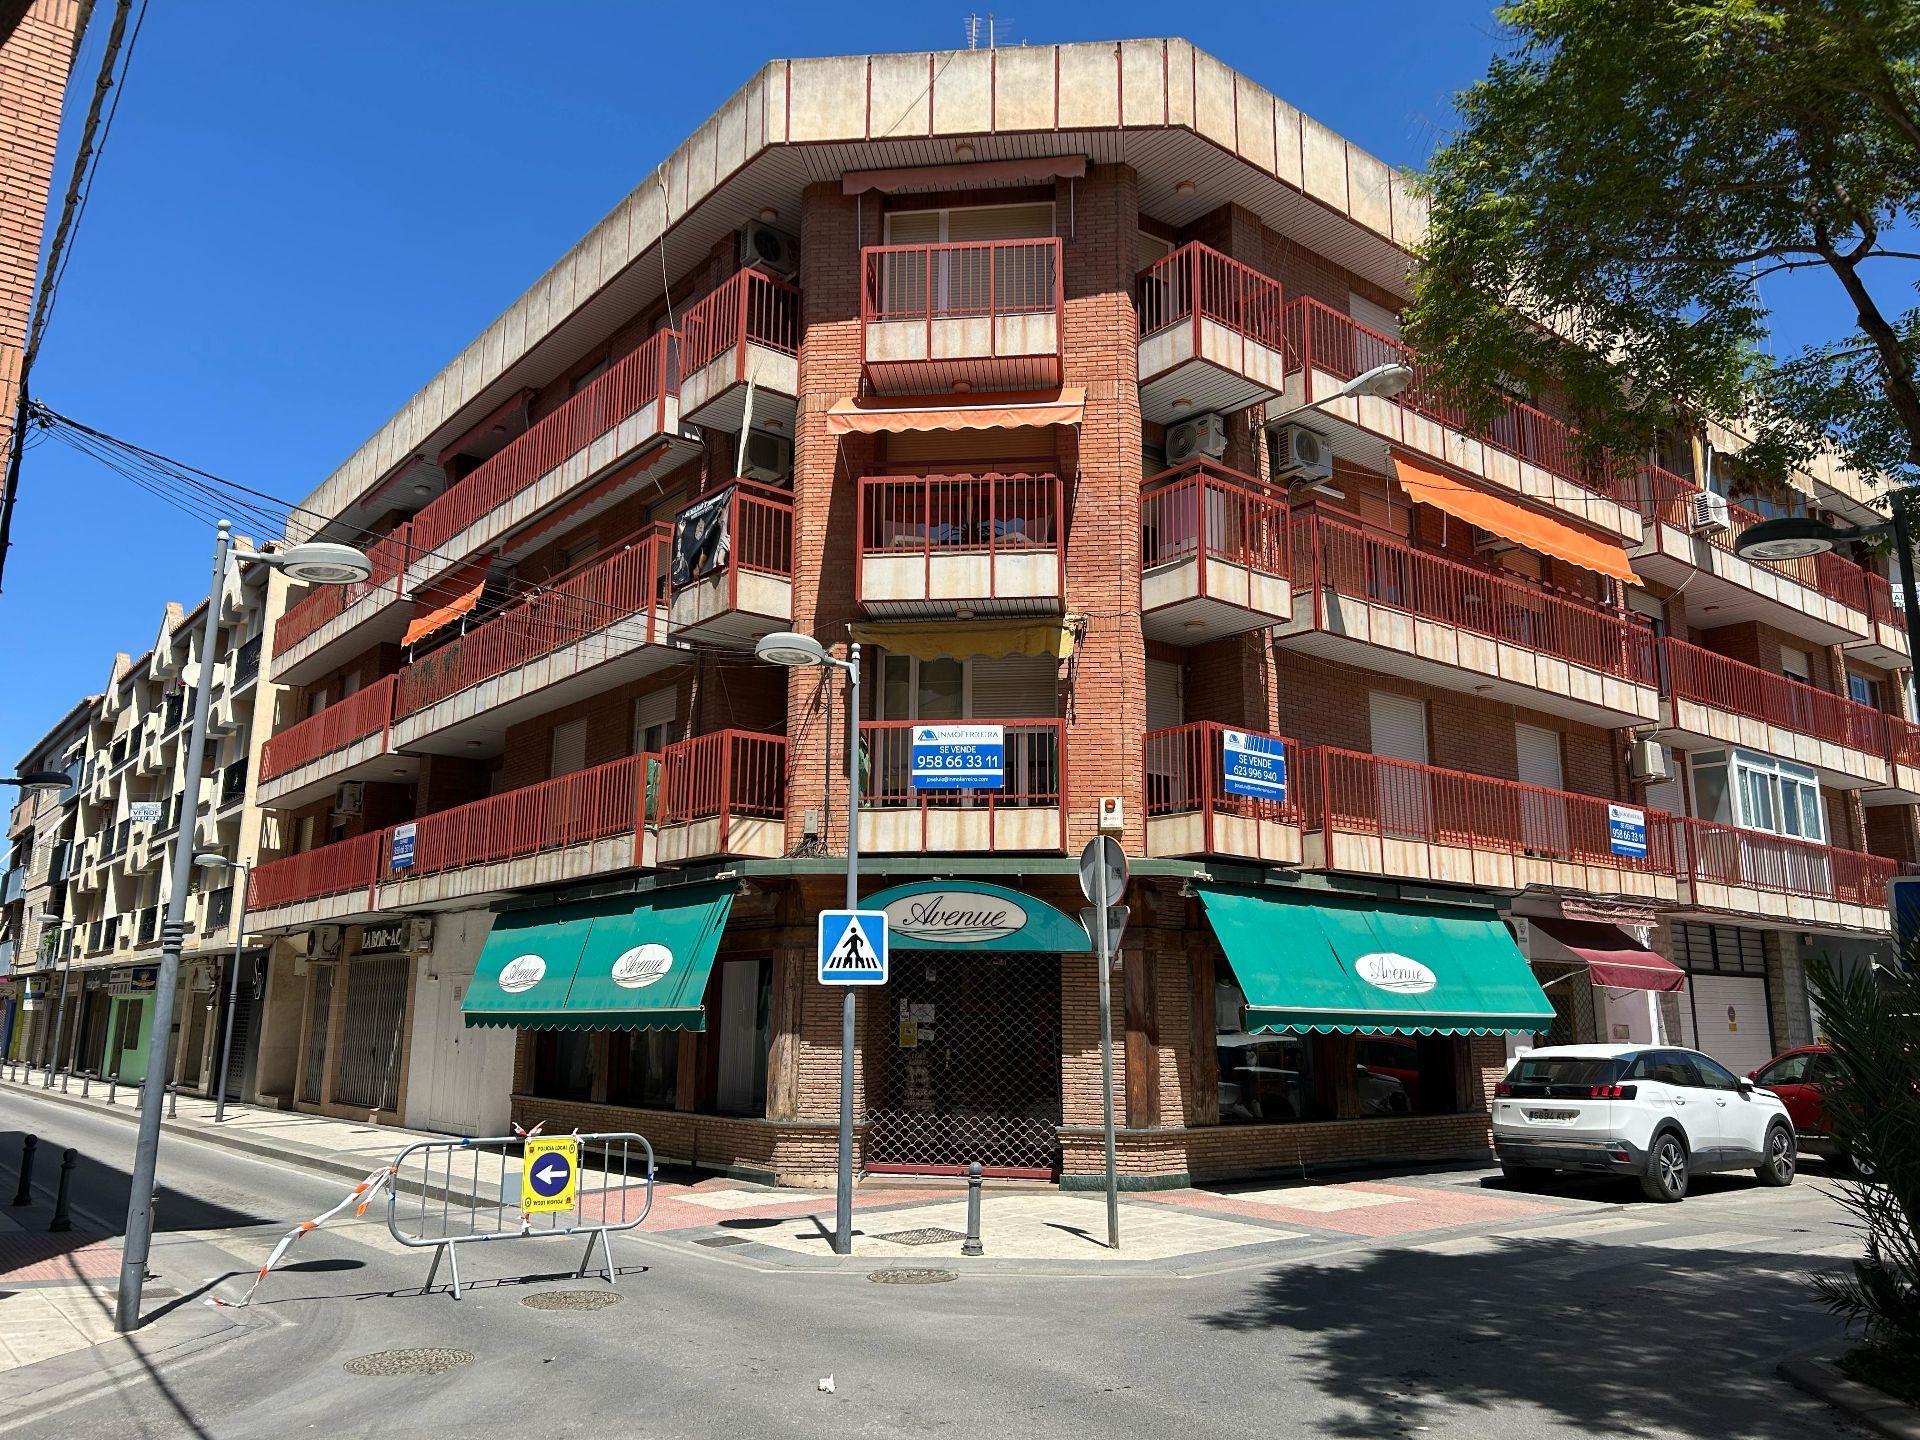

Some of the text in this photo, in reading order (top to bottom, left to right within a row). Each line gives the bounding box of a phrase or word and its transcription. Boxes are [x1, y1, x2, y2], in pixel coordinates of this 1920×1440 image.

[939, 745, 977, 754] SE VENDE
[917, 755, 999, 768] 958 66 33 11
[1238, 754, 1272, 769] SE VENDE
[1233, 765, 1277, 782] 623 996 940
[1631, 832, 1639, 842] 33
[902, 895, 1007, 927] Avenue
[504, 957, 541, 981] Avenue
[619, 947, 665, 975] Avenue
[1369, 956, 1425, 981] Avenue
[1534, 1111, 1554, 1120] 5694
